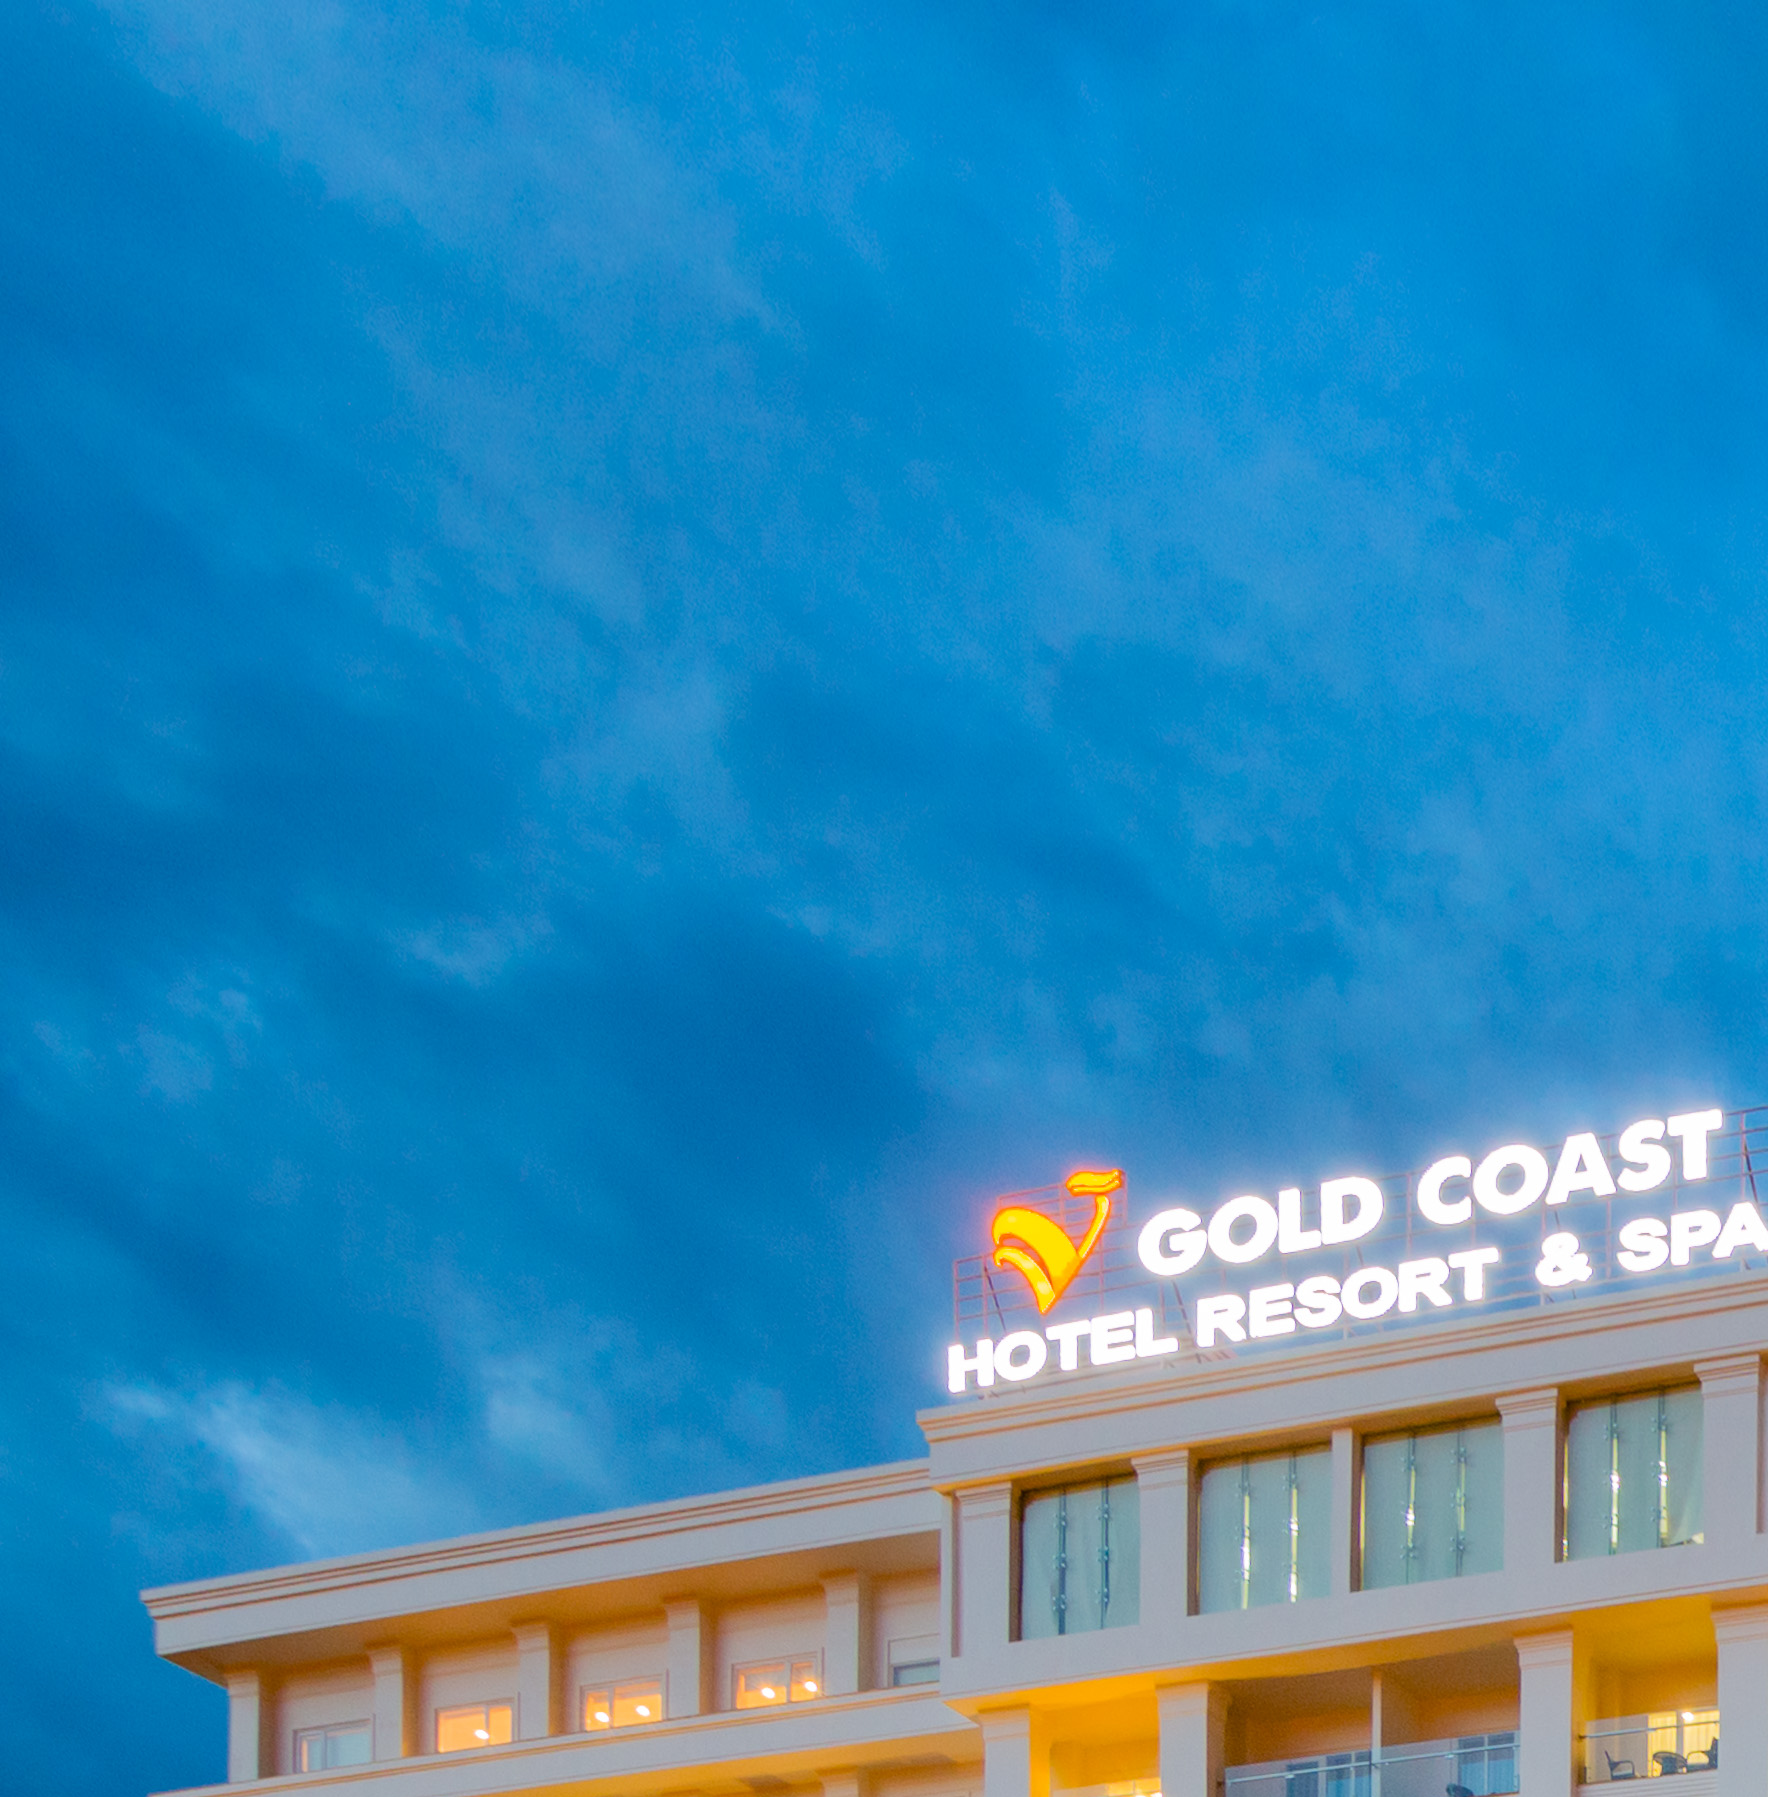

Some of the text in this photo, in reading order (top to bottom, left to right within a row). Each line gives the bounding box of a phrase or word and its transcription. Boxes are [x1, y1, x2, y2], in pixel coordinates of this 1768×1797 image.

[1137, 1108, 1724, 1276] GOLD COAST
[947, 1307, 1179, 1394] HOTEL
[1196, 1248, 1499, 1348] RESORT
[1535, 1232, 1593, 1287] &
